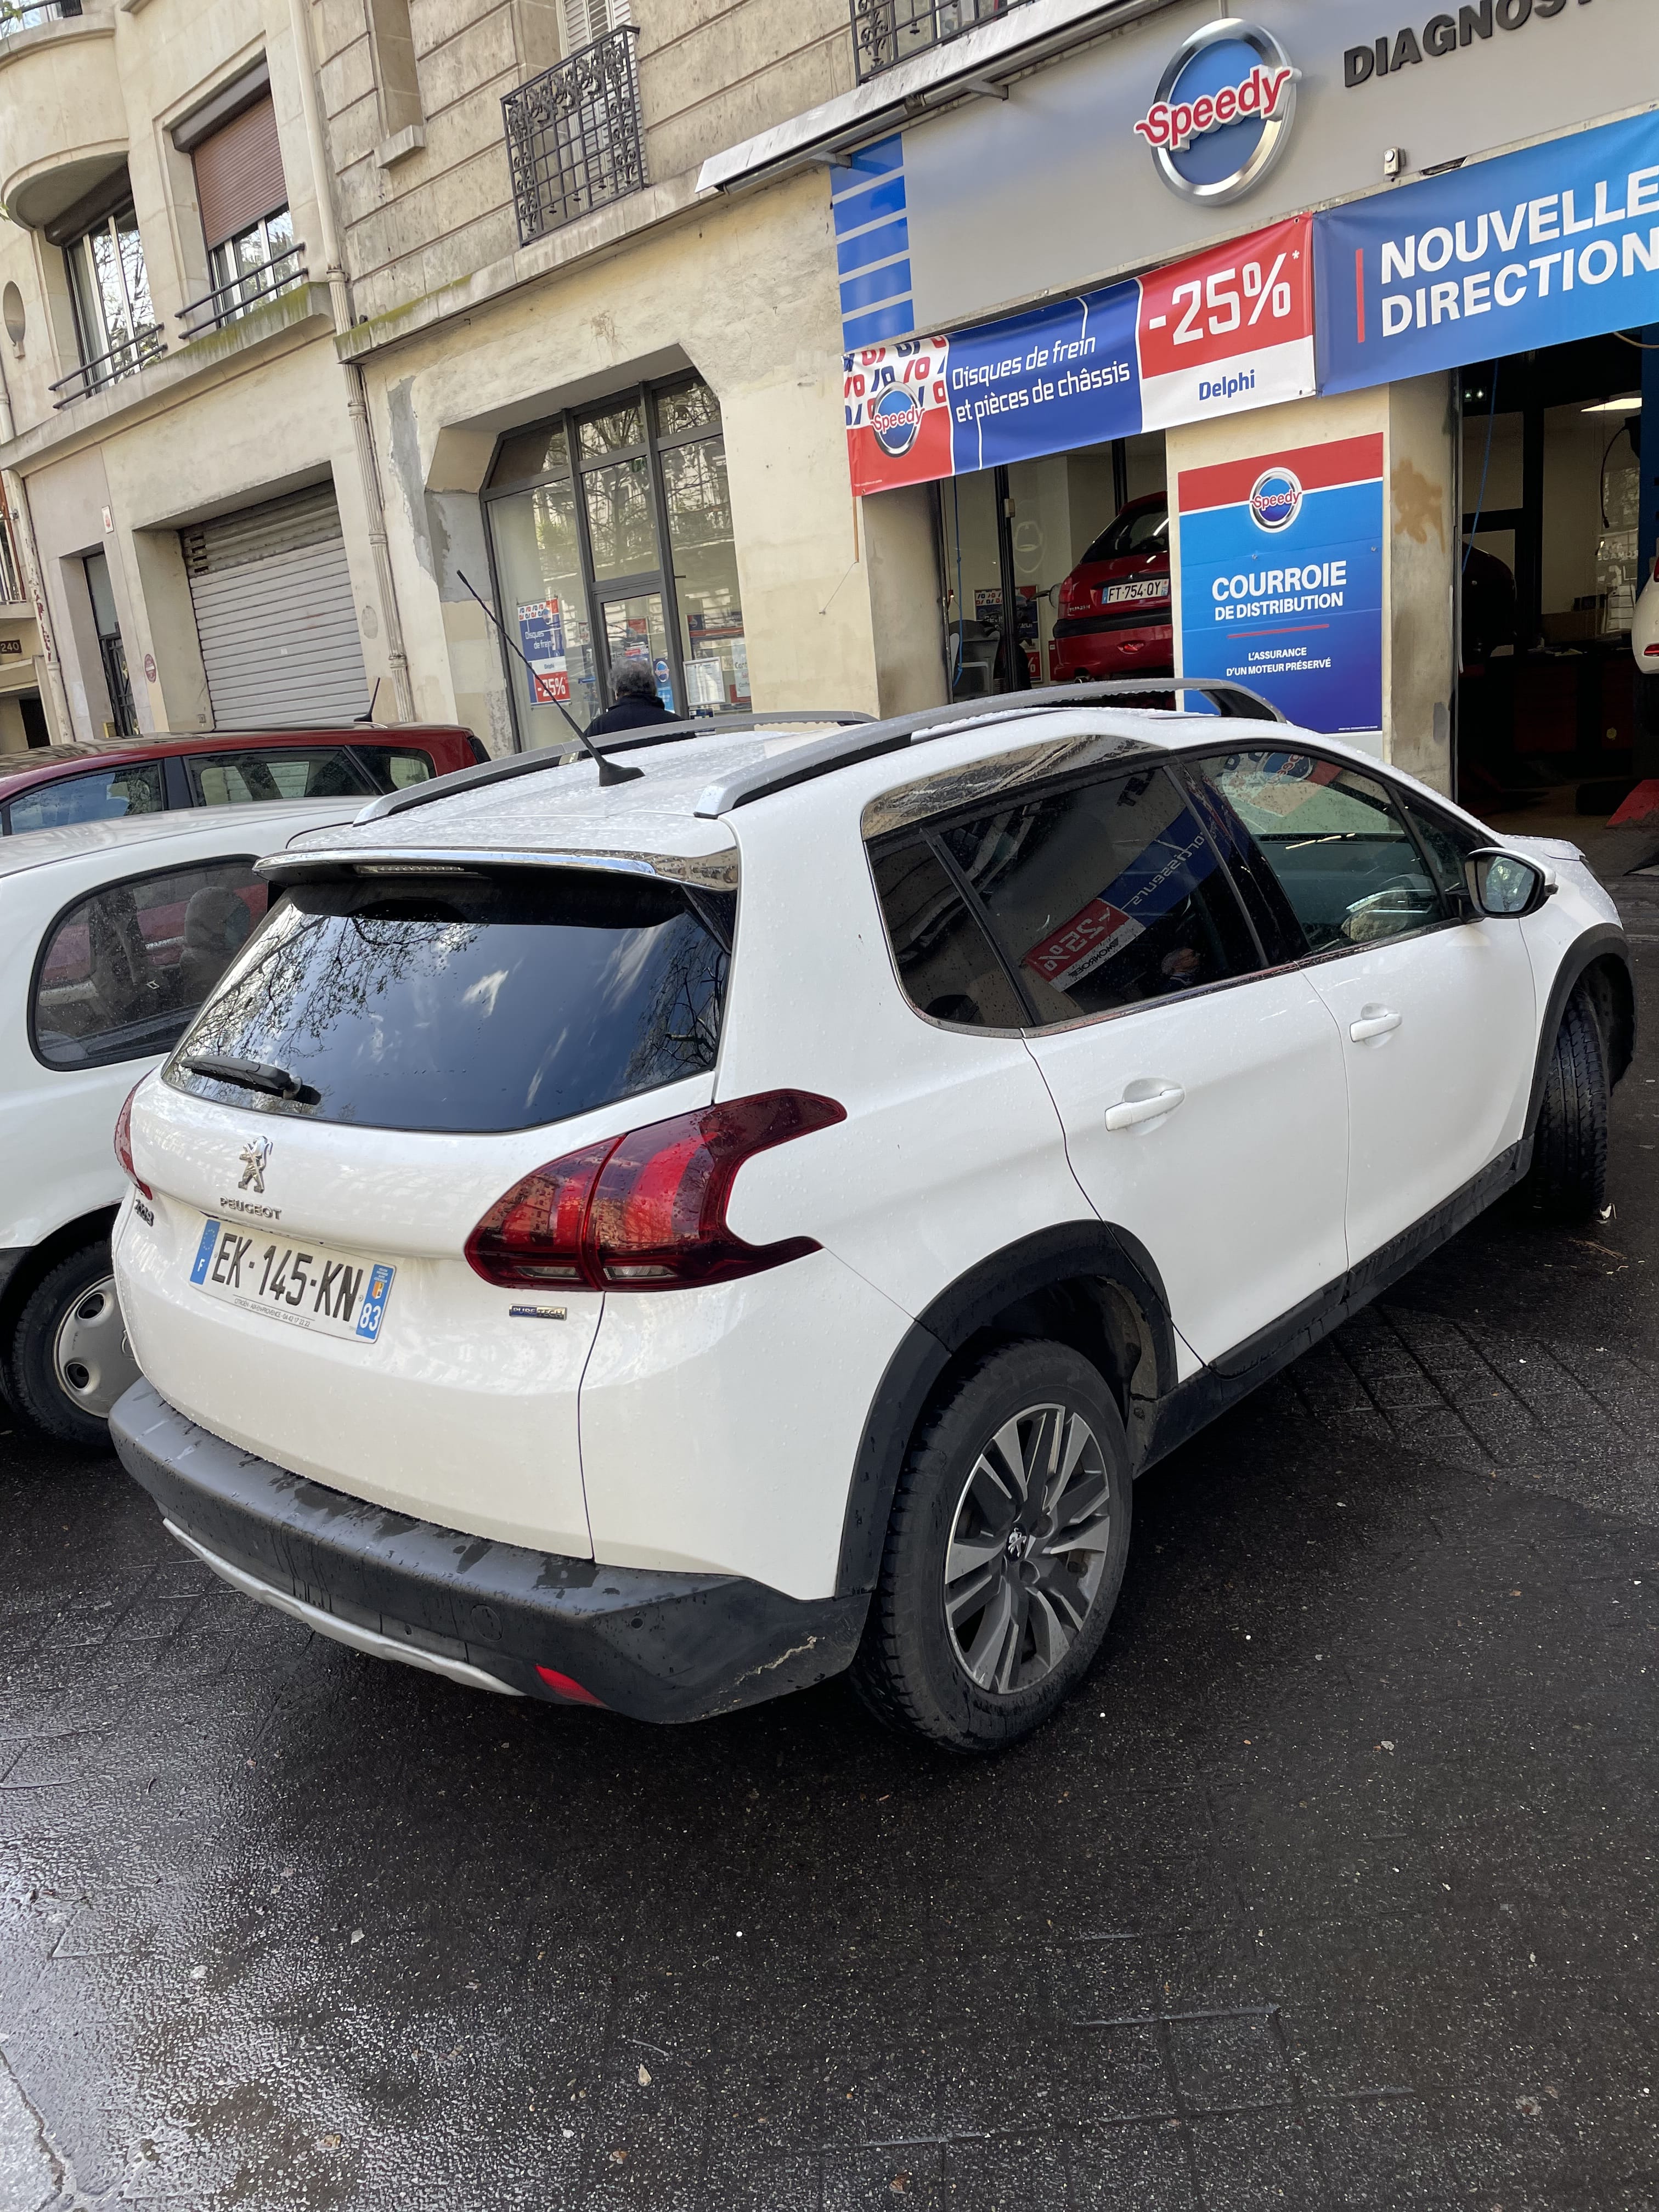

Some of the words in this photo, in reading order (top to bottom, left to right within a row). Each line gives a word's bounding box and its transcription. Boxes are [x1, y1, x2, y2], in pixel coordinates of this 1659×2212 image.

[1344, 0, 1591, 88] DIAGNO
[1135, 68, 1291, 147] Speedy
[1381, 165, 1659, 285] NOUVELLE
[1382, 226, 1659, 337] DIRECTION
[952, 357, 1022, 391] Disques
[1025, 346, 1049, 371] de
[1052, 336, 1096, 364] frein
[956, 399, 973, 423] et
[974, 389, 1029, 421] pièces
[1031, 379, 1054, 404] de
[1057, 360, 1131, 397] châssis
[1198, 369, 1255, 401] Delphi
[870, 405, 926, 433] Speedy
[1250, 489, 1302, 510] Speedy
[1211, 560, 1347, 601] COURROIE
[1215, 605, 1234, 621] DE
[1236, 591, 1344, 619] DISTRIBUTION
[1, 642, 19, 652] 240
[1248, 647, 1307, 661] L'ASSURANCE
[1226, 666, 1247, 676] D'UN
[1248, 663, 1287, 675] MOTEUR
[1285, 657, 1331, 672] PRÉSERVÉ
[219, 1196, 282, 1220] PEUGEOT
[197, 1258, 205, 1273] F
[211, 1232, 364, 1322] EK-145-KN
[359, 1302, 382, 1331] 83
